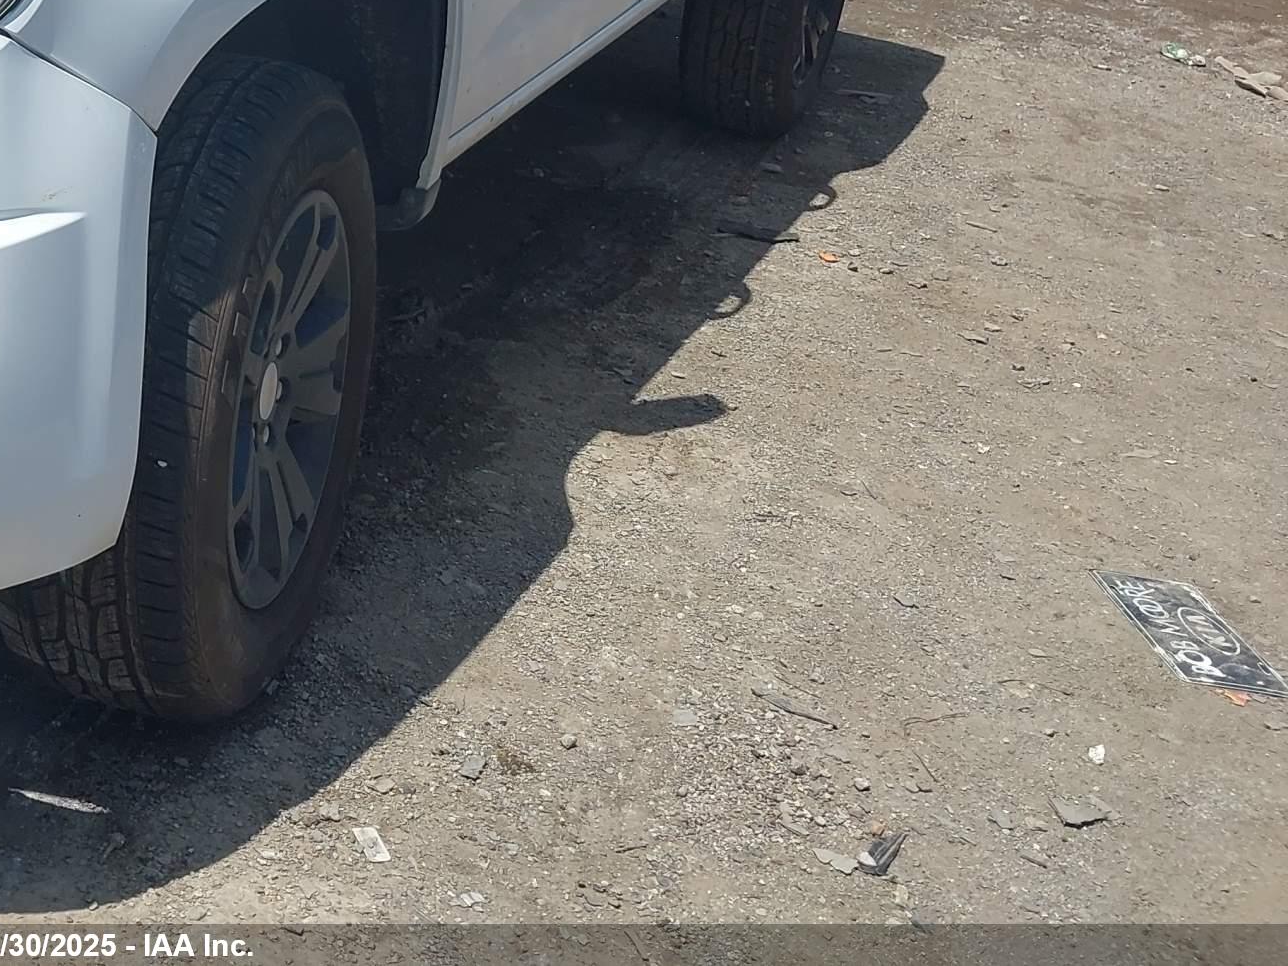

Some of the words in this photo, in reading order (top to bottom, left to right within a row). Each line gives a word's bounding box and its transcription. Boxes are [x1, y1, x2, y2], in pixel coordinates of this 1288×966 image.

[1113, 580, 1188, 637] MOORE
[1186, 615, 1234, 647] KIA
[1170, 640, 1227, 678] BOB
